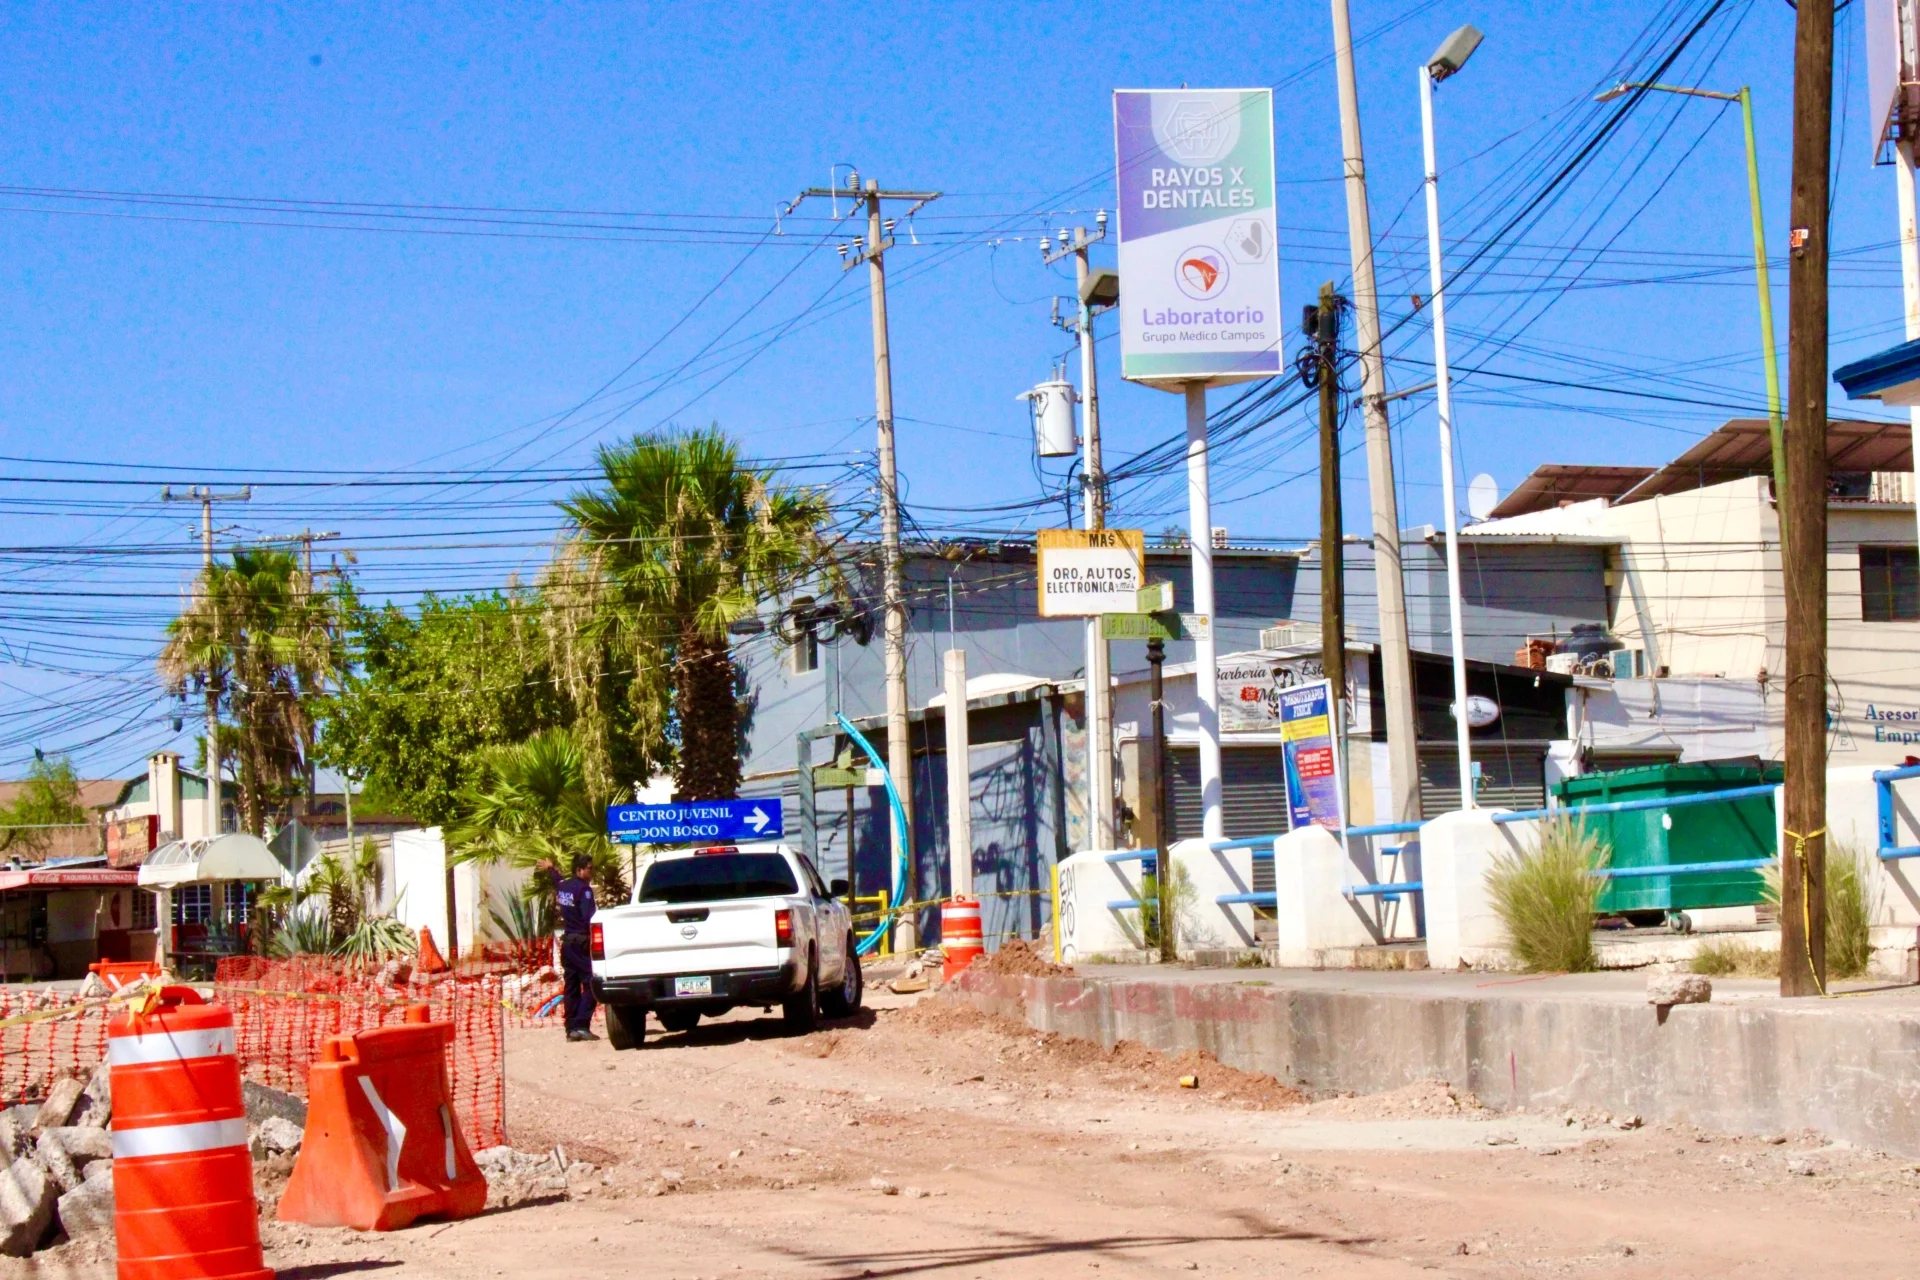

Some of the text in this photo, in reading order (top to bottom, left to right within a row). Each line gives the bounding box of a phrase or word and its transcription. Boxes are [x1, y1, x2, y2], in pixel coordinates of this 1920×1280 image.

[1152, 167, 1245, 187] RAYOS X
[1143, 188, 1255, 209] DENTALES
[1142, 306, 1265, 326] Laboratorio
[1142, 332, 1177, 346] Grupo
[1220, 330, 1266, 344] Campos
[1053, 567, 1137, 581] ORO, AUTOS,
[1047, 581, 1115, 594] ELECTRONICA
[1864, 704, 1920, 720] Asesor
[1874, 725, 1920, 746] Empr
[619, 807, 733, 823] CENTRO JUVENIL
[640, 827, 670, 839] DON
[672, 825, 719, 837] BOSCO
